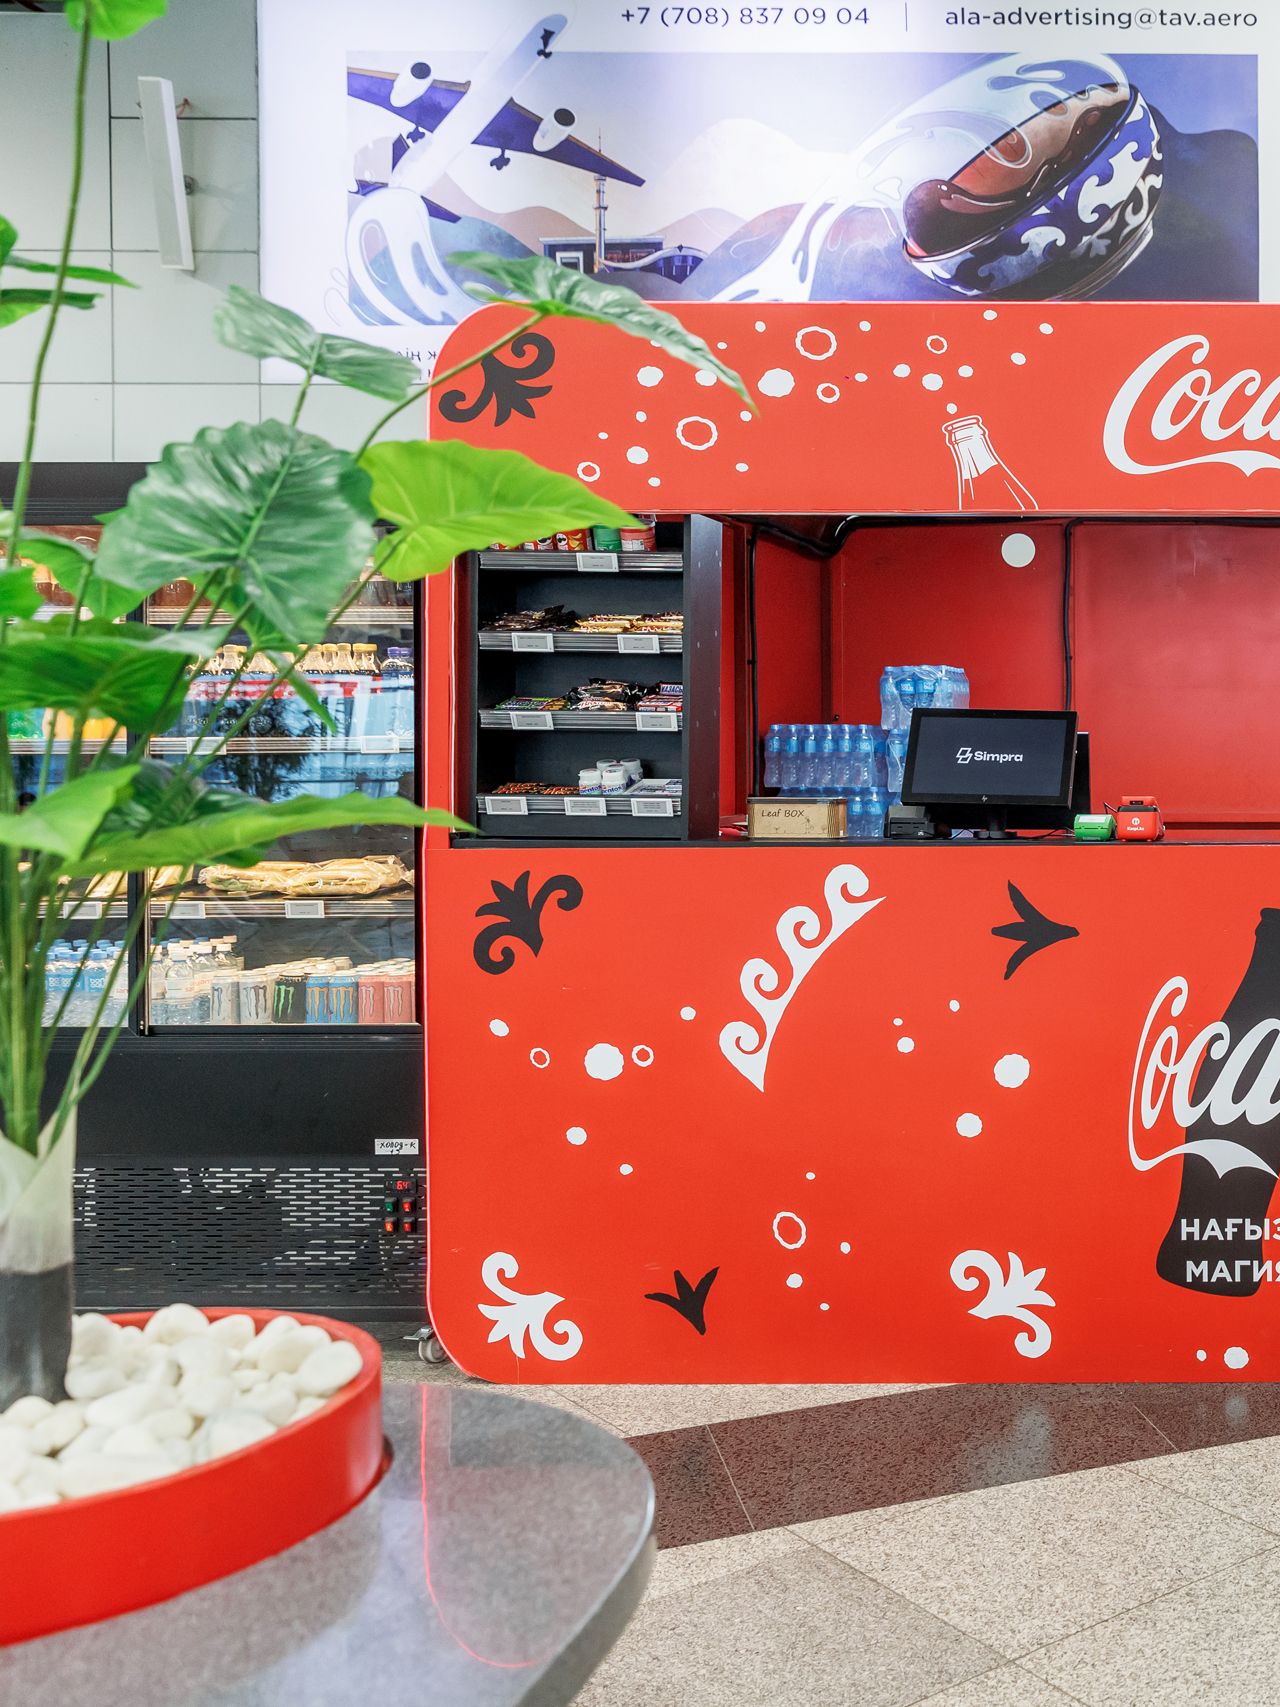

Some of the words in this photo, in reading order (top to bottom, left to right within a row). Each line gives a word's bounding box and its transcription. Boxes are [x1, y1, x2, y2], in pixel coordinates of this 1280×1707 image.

[621, 7, 650, 24] +7
[660, 7, 730, 28] (708)
[740, 7, 784, 25] 837
[794, 7, 826, 25] 09
[836, 7, 870, 25] 04
[945, 7, 1258, 30] ala-advertising@tav.aero
[973, 751, 1023, 764] Simpra
[761, 809, 781, 818] Leaf
[784, 809, 805, 817] BOX
